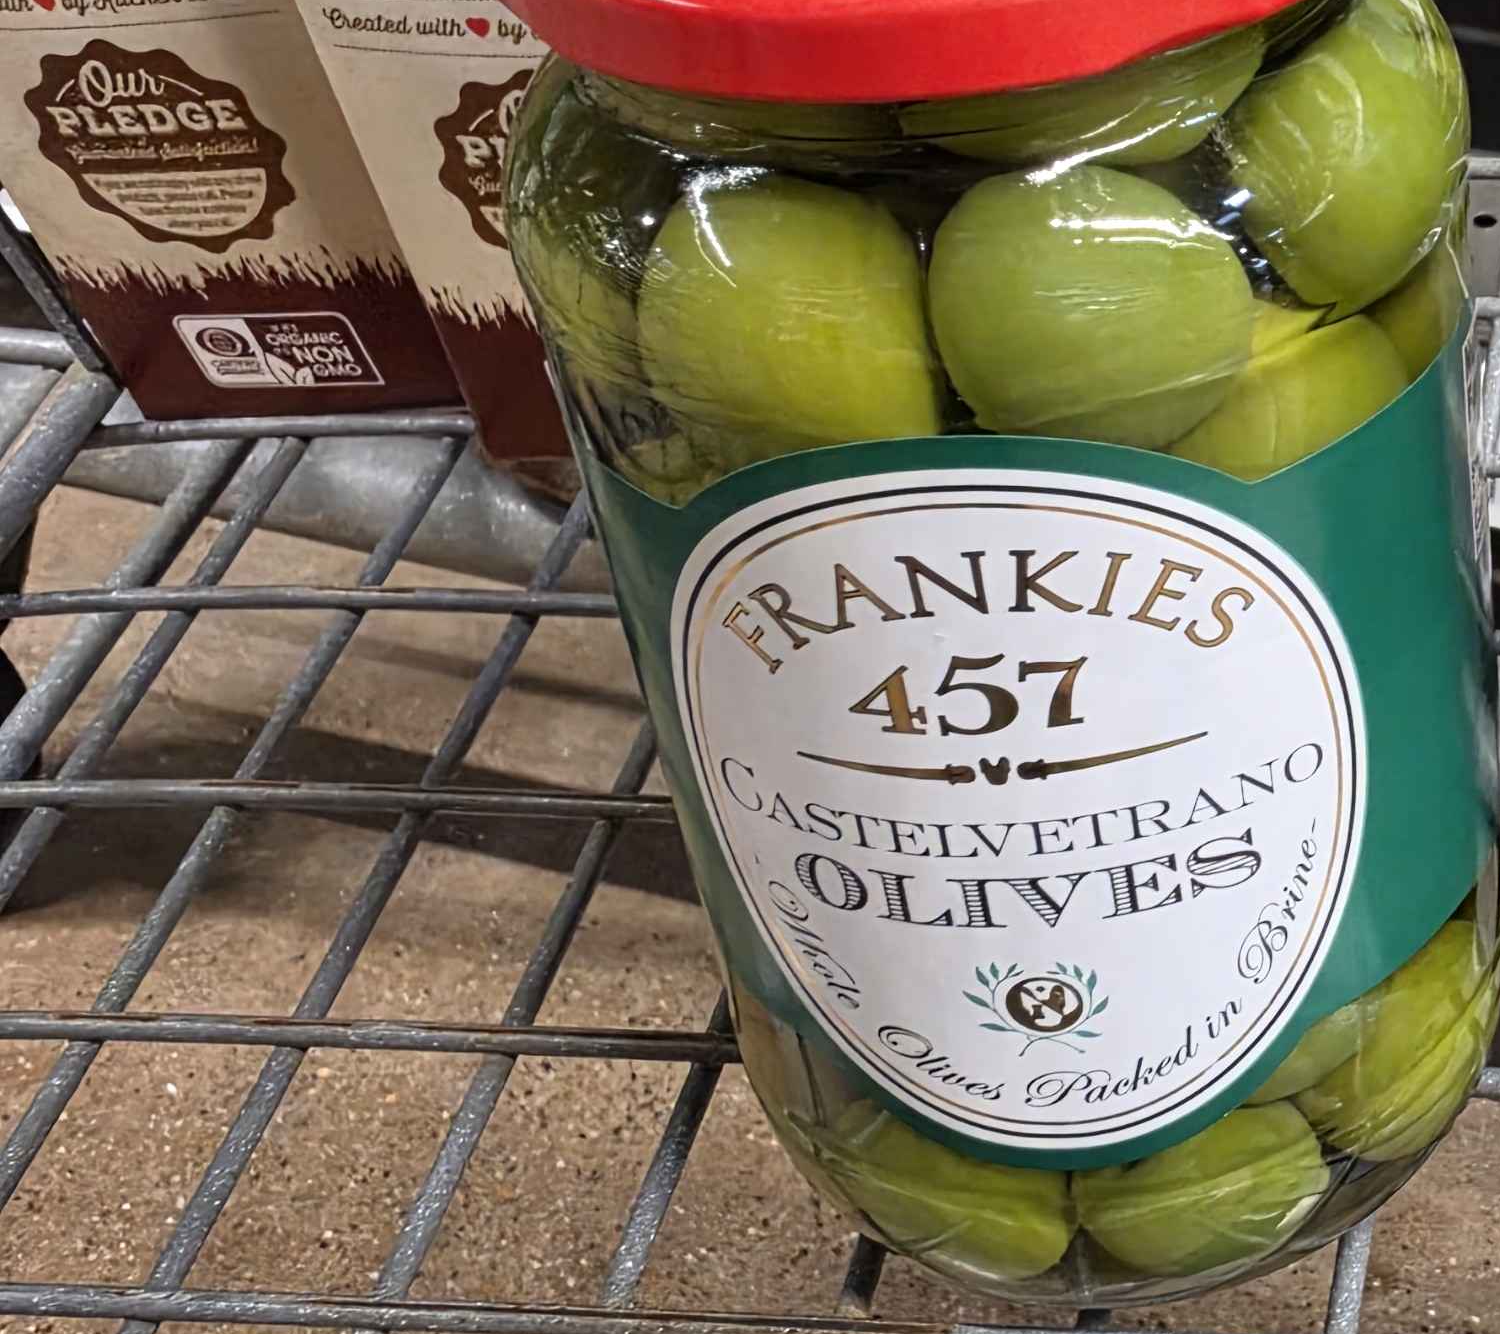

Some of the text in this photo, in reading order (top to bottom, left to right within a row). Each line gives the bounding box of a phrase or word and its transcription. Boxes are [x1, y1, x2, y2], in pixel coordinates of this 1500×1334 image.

[321, 6, 530, 45] Created with by
[78, 59, 166, 108] Our
[46, 97, 250, 138] PLEDGE
[292, 344, 355, 365] NON
[312, 363, 363, 378] GMO
[721, 549, 1256, 675] FRANKIES
[848, 652, 1090, 738] 457
[720, 742, 1325, 859] CASTELVETRANO
[794, 827, 1263, 930] OLIVES
[768, 879, 862, 1012] Whole
[877, 1023, 1003, 1103] Olives
[1024, 1024, 1200, 1109] Packed
[1196, 995, 1246, 1043] in
